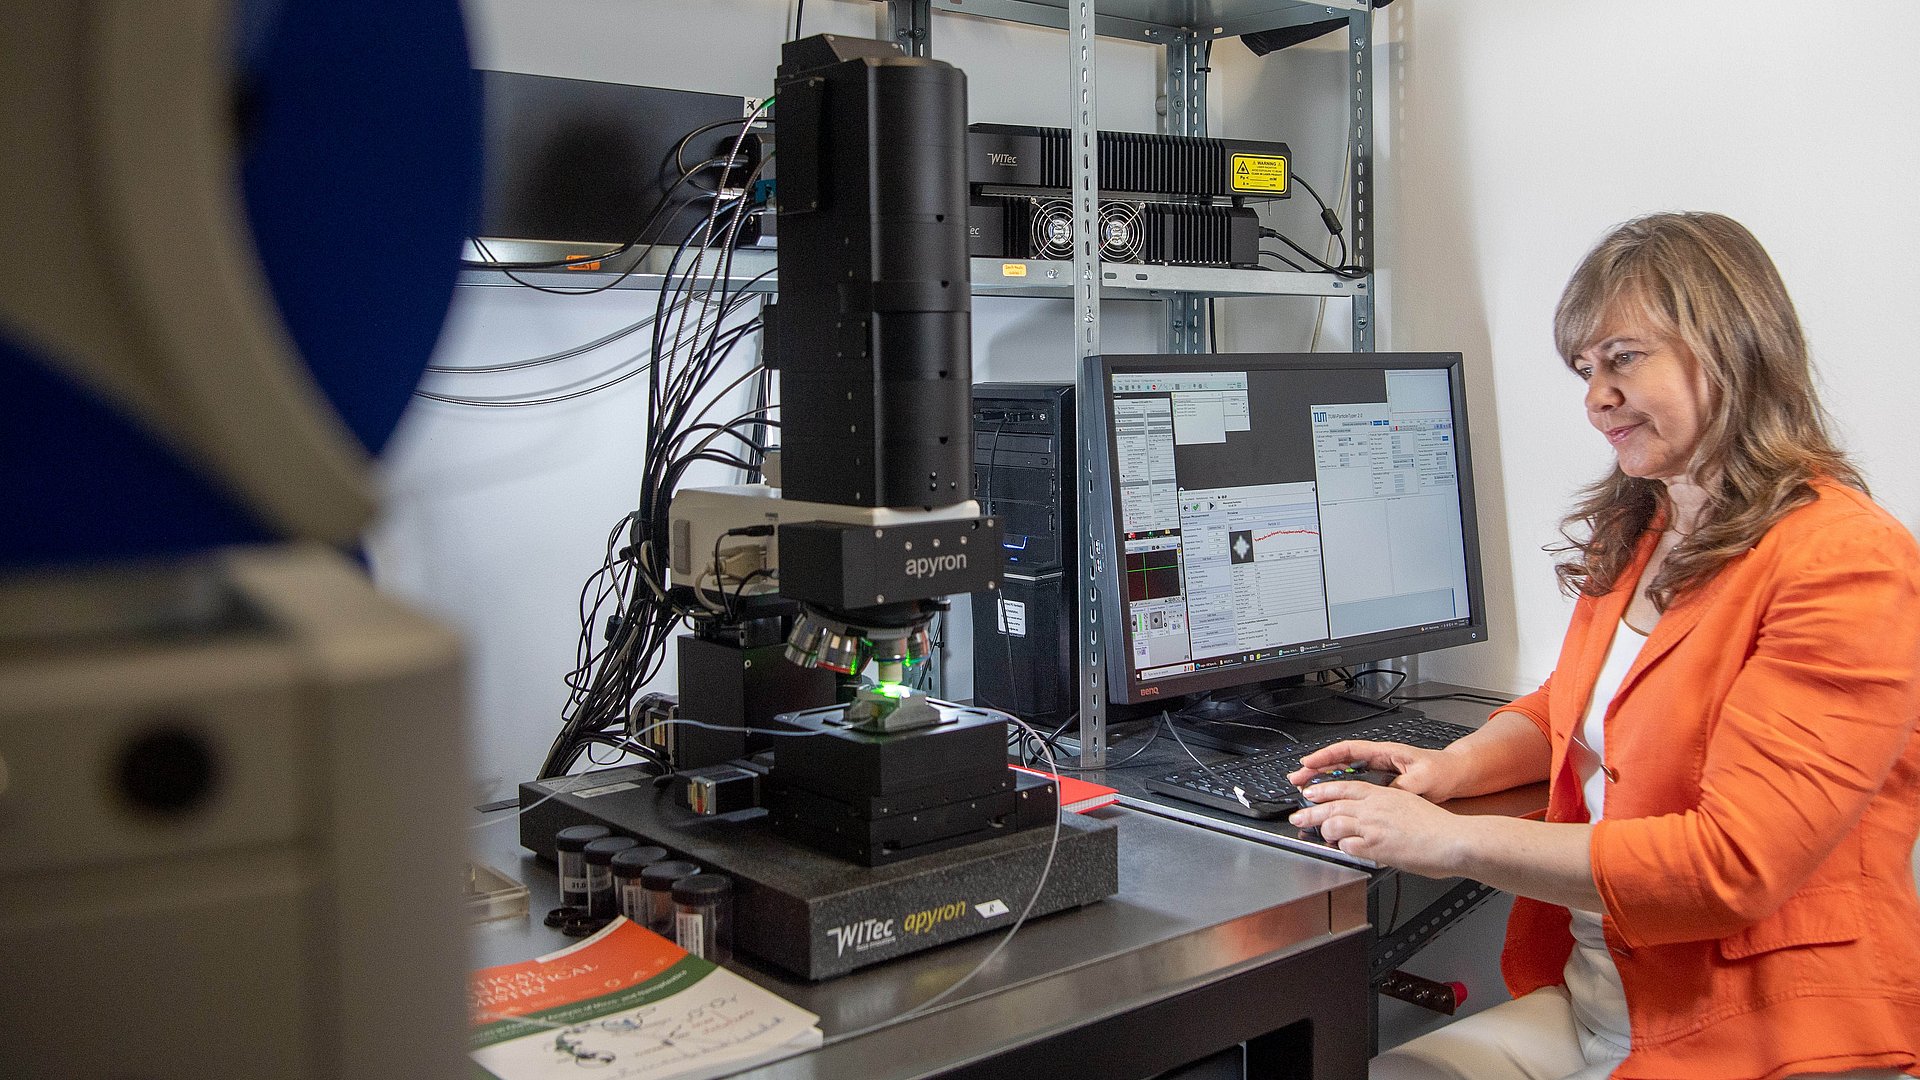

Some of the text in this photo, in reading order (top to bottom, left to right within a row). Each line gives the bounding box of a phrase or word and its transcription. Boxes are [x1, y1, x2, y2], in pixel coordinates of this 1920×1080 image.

[987, 153, 1017, 165] WITec
[905, 554, 967, 578] apyron
[827, 900, 966, 958] WITec apyron
